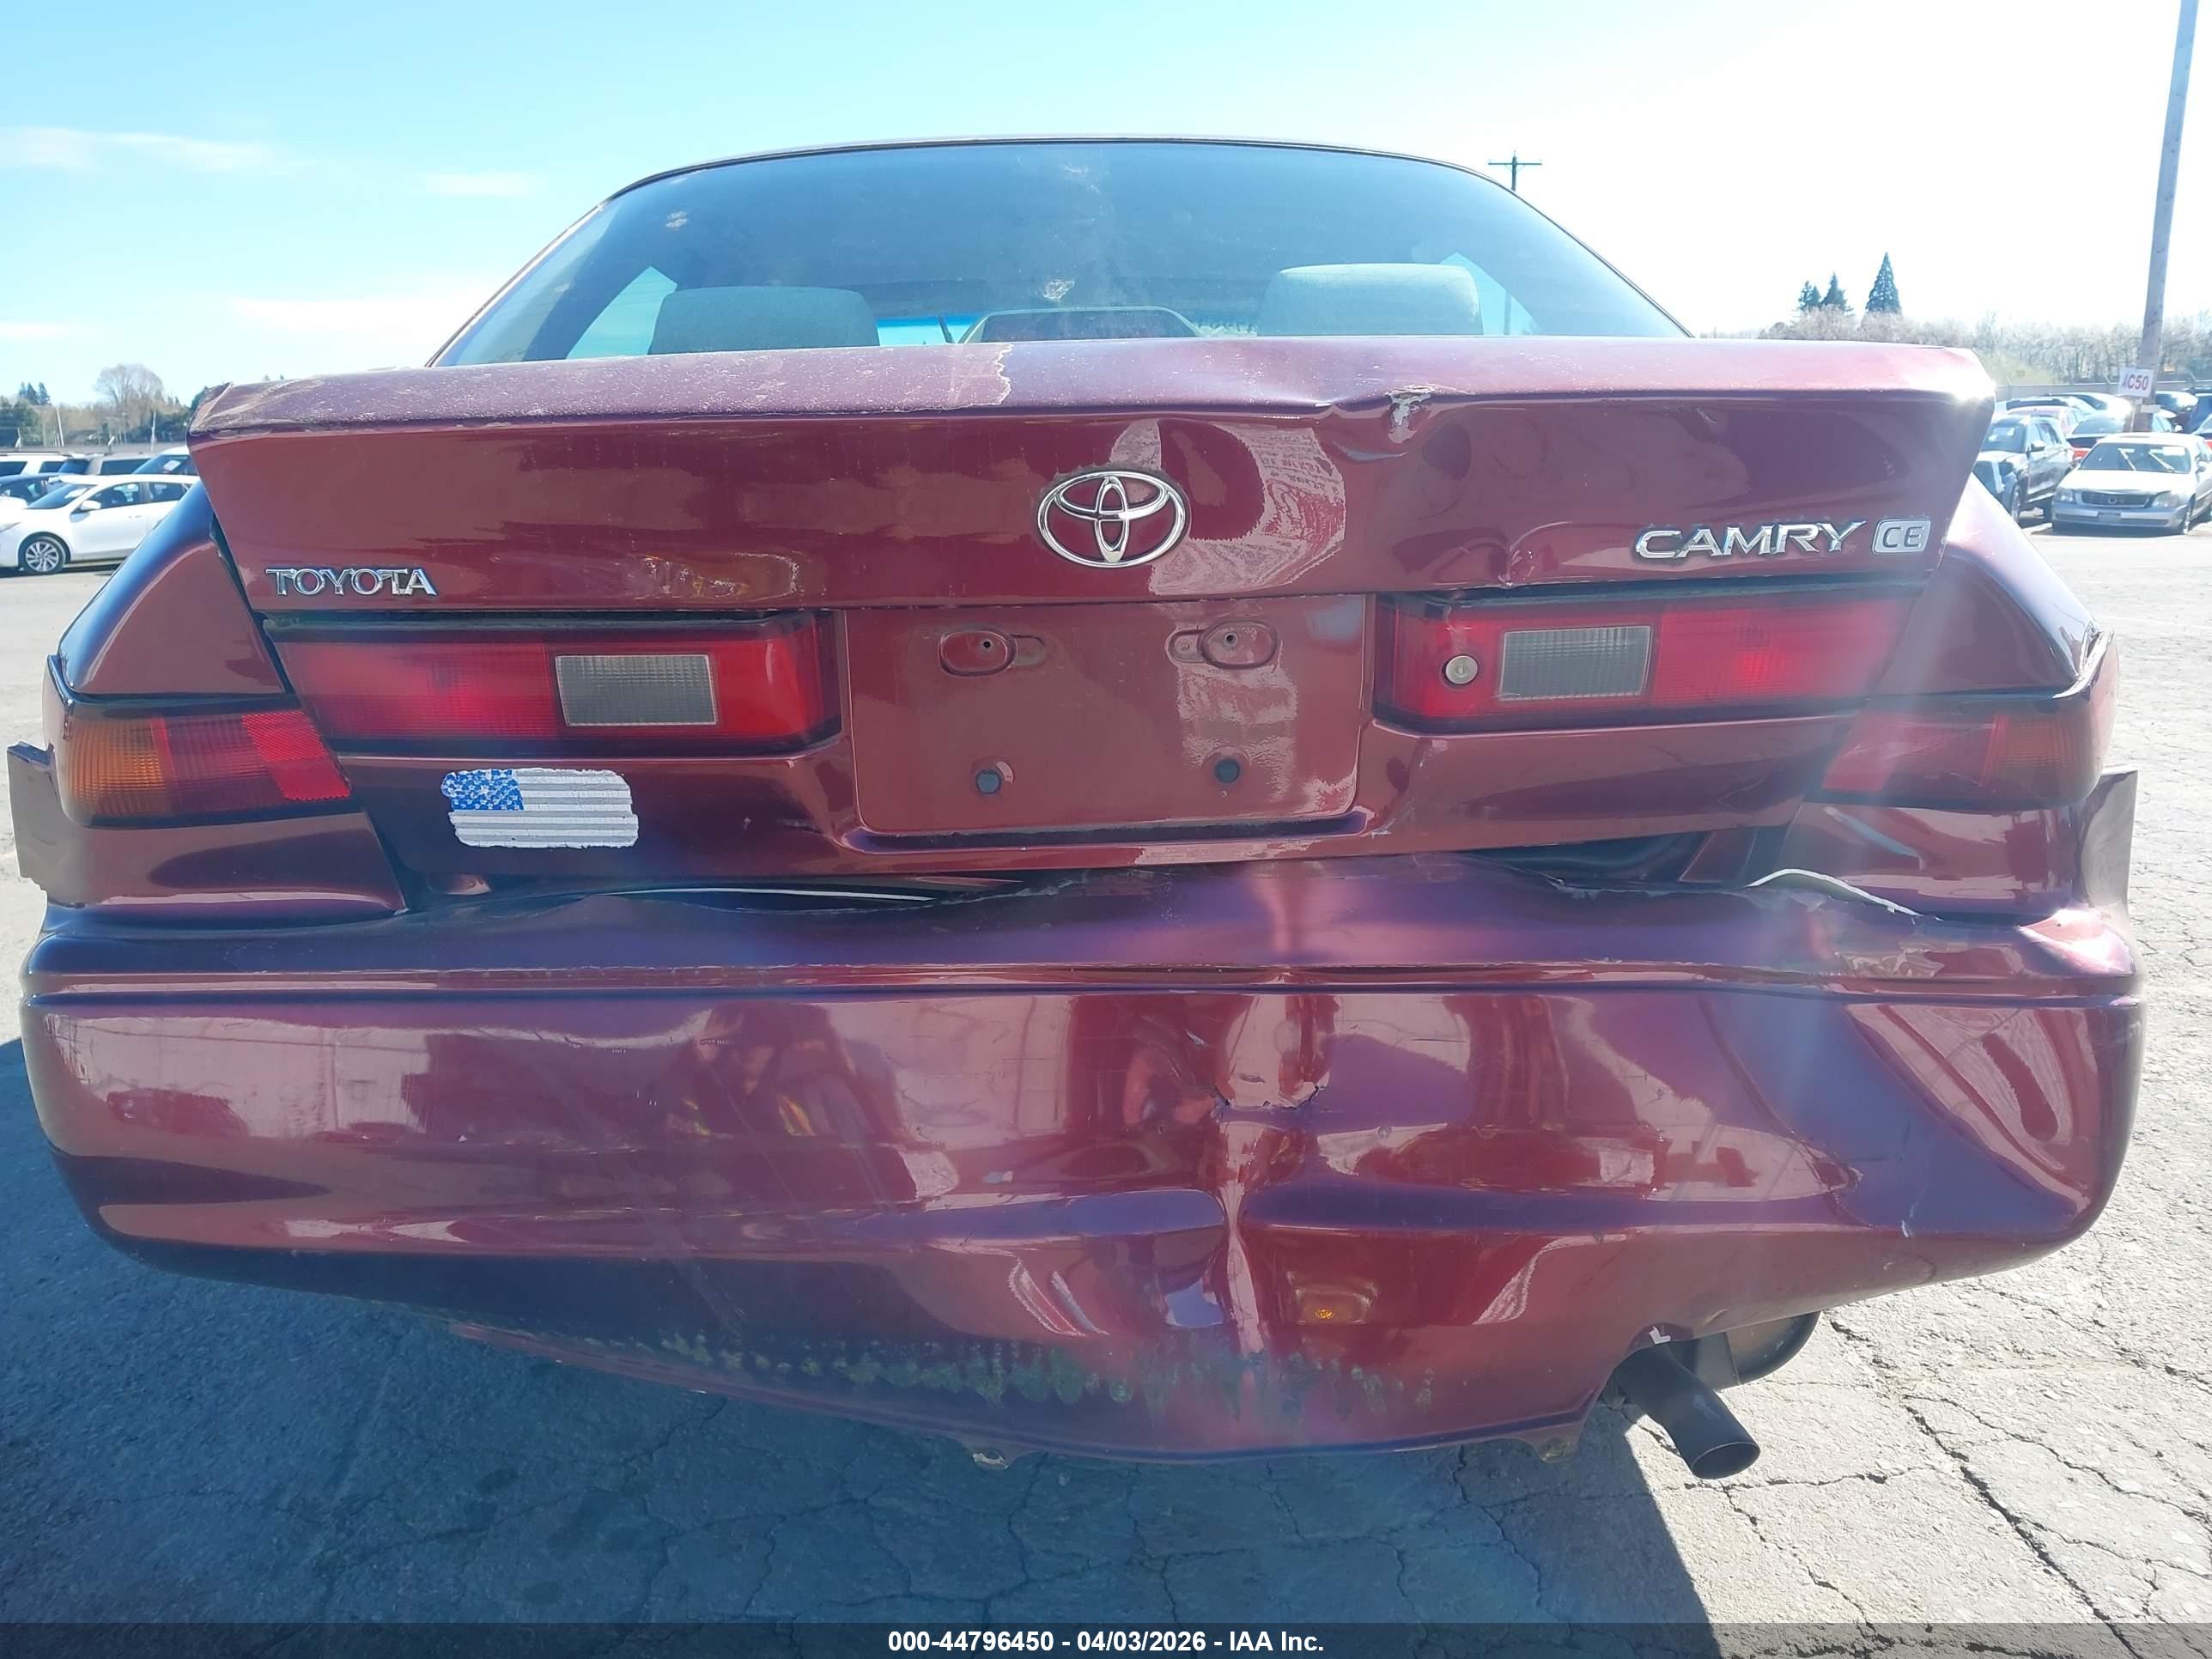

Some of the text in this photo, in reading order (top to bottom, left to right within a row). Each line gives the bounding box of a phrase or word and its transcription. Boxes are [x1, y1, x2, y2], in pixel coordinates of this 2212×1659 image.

[1635, 520, 1923, 558] CAMRY CE
[265, 568, 437, 595] TOYOTA
